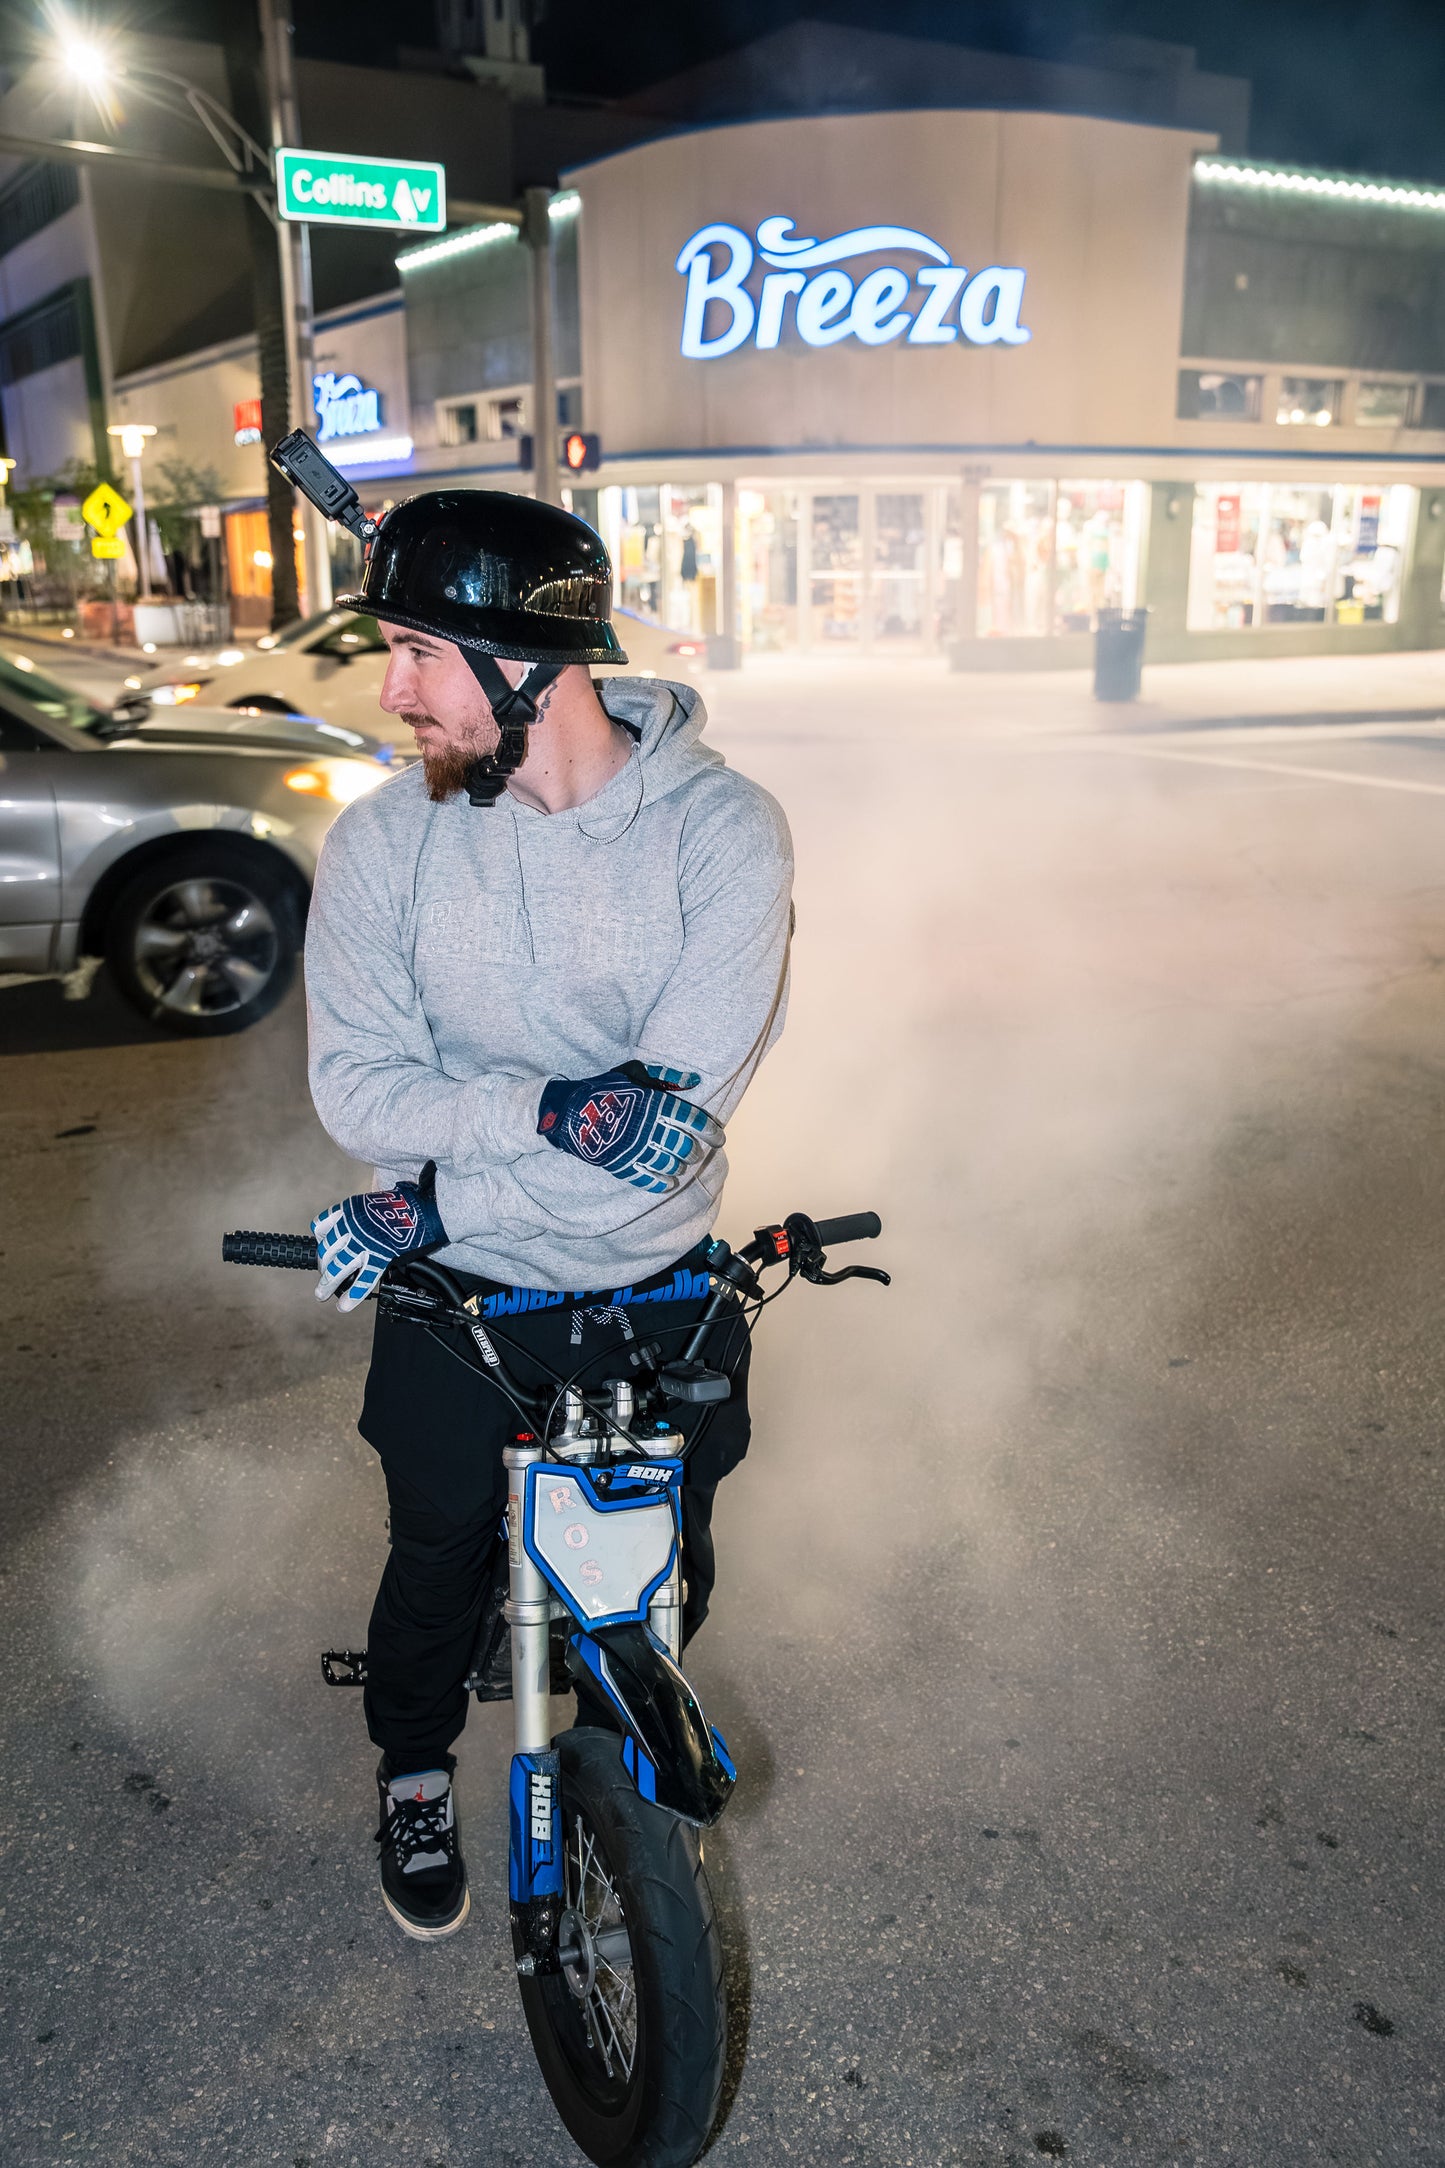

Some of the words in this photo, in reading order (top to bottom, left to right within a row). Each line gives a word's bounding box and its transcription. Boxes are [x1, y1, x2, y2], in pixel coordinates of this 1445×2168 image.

[292, 169, 387, 209] Collins
[392, 179, 432, 222] Av
[675, 220, 1032, 360] Breeza
